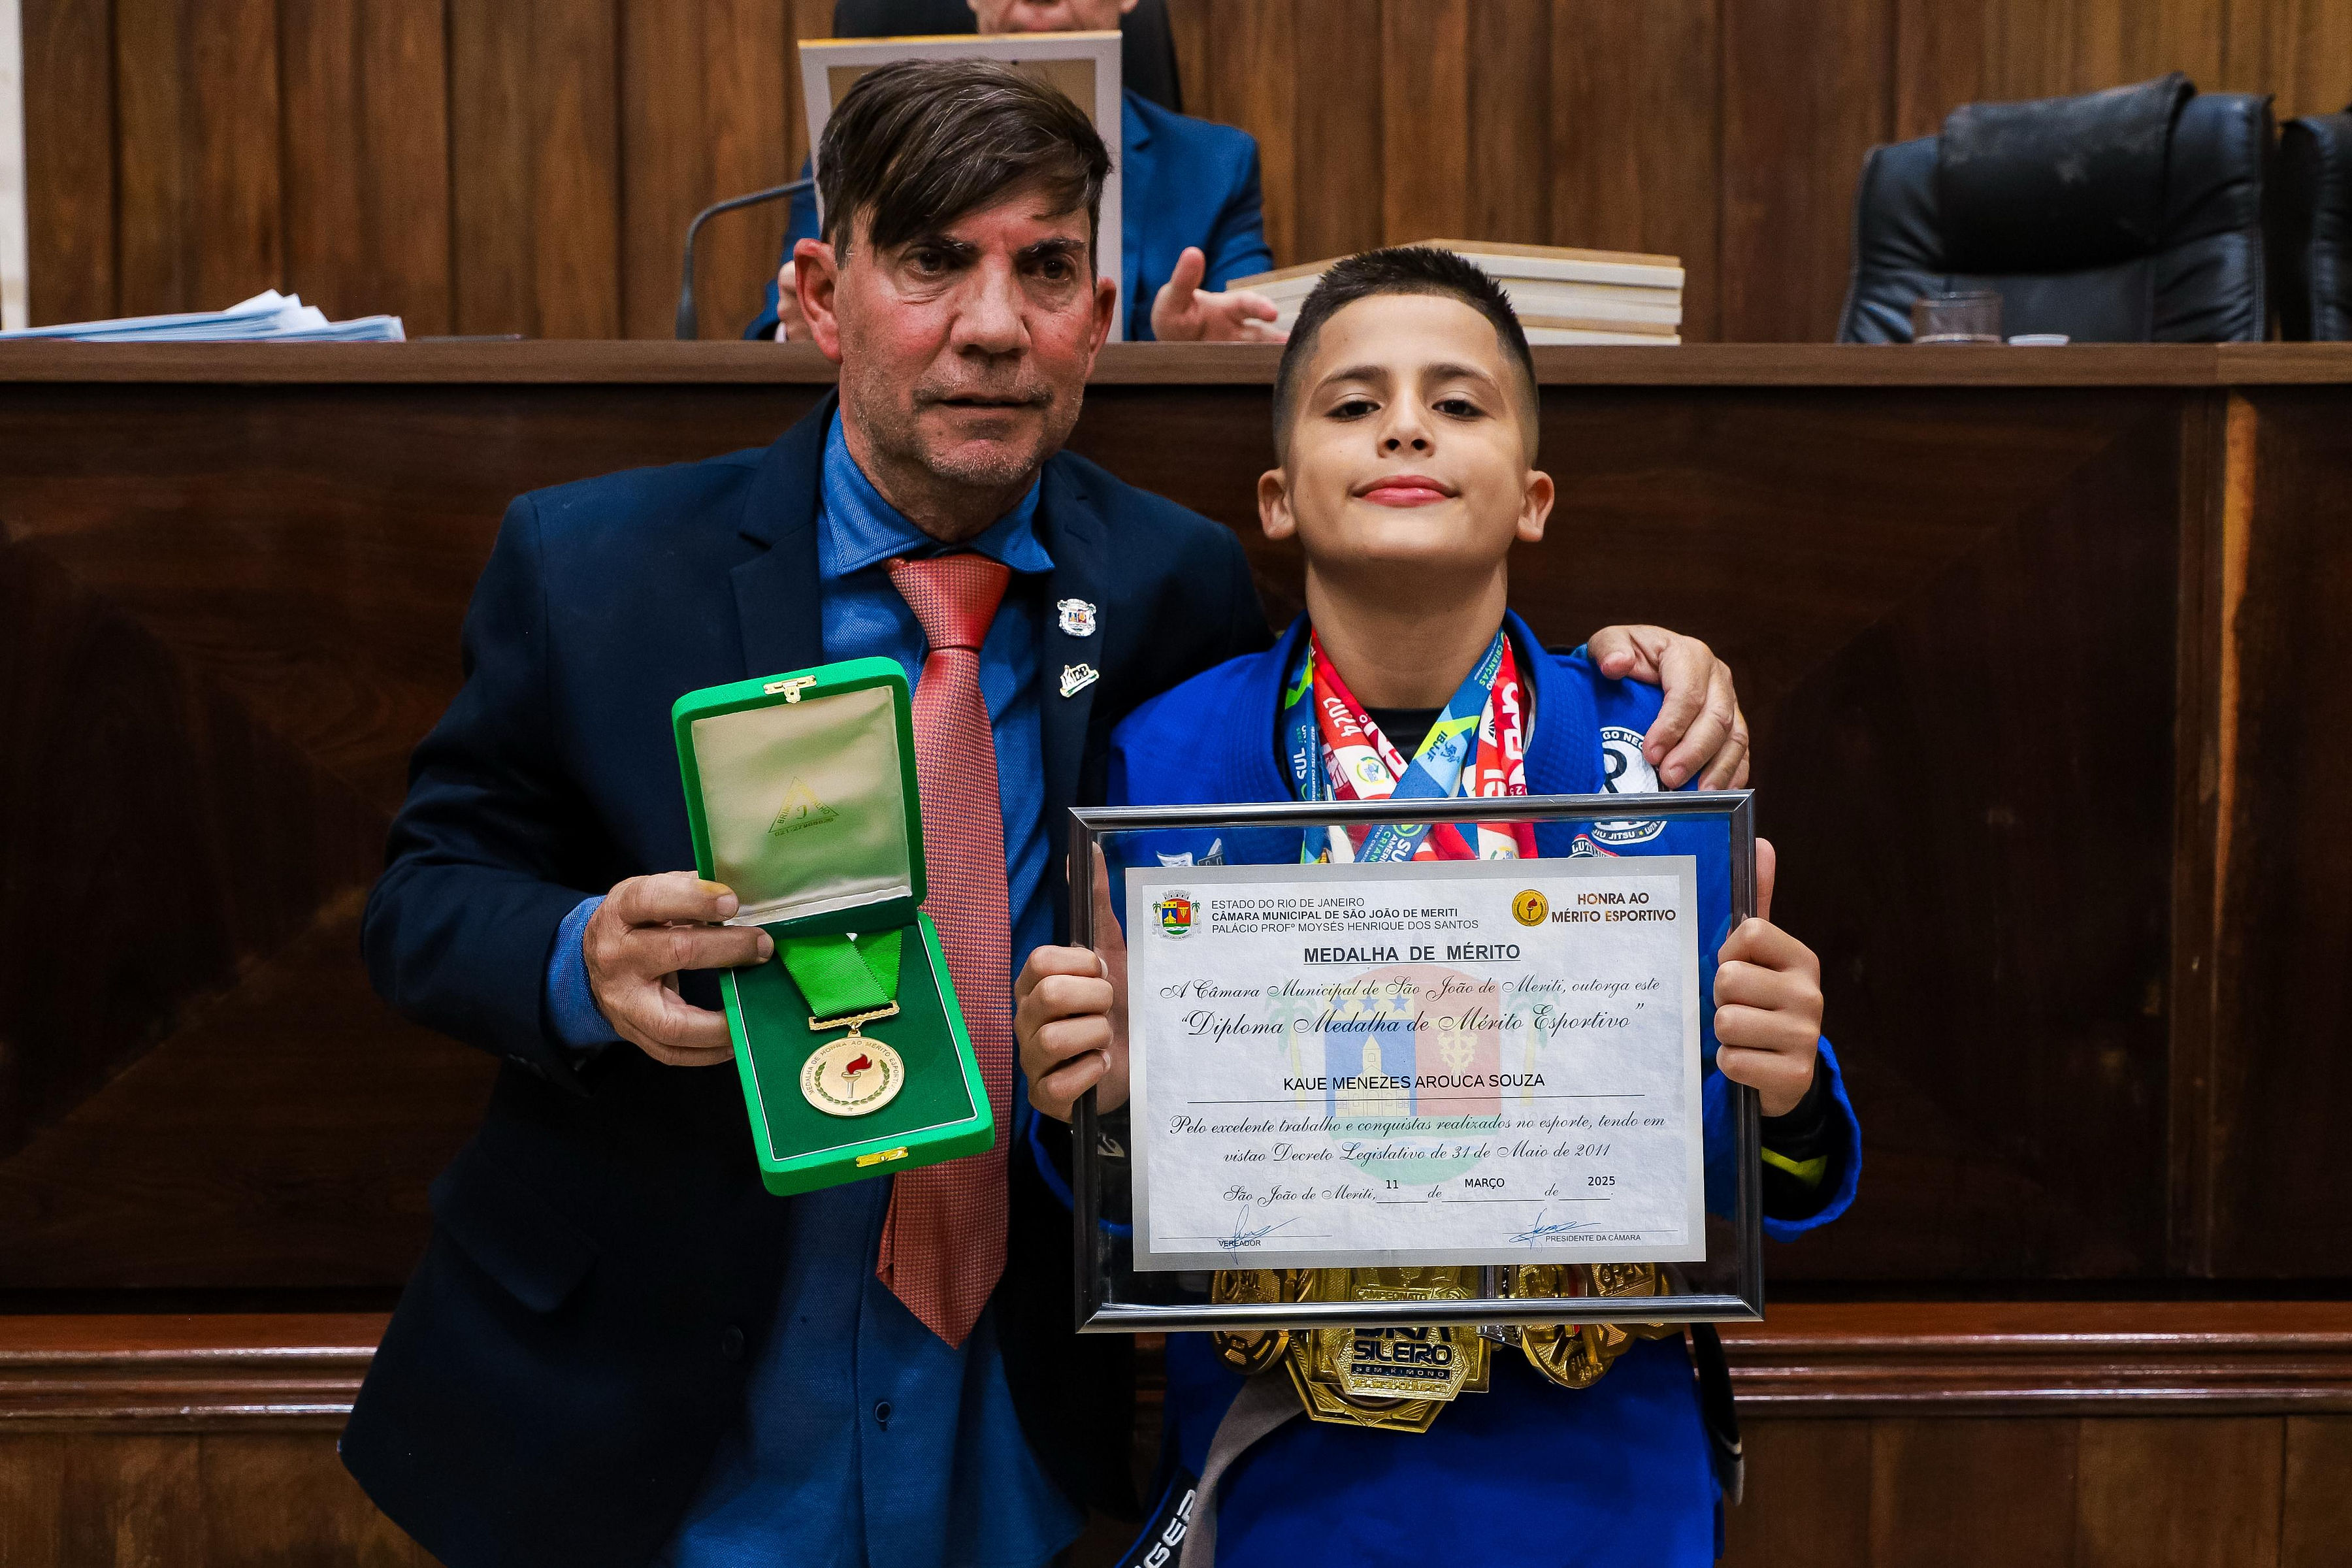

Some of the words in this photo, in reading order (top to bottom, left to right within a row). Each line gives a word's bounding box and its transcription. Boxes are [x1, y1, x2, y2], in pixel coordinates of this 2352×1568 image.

[1427, 730, 1448, 762] IBJJF
[1609, 831, 1635, 840] JITSU
[1391, 838, 1412, 862] SU
[1212, 900, 1256, 909] ESTADO
[1258, 899, 1274, 907] DO
[1277, 898, 1296, 907] RIO
[1299, 898, 1315, 907] DE
[1317, 898, 1364, 907] JANEIRO
[1578, 893, 1625, 905] HONRA
[1629, 892, 1649, 904] AO
[1212, 910, 1260, 921] CÂMARA
[1263, 911, 1321, 920] MUNICIPAL
[1325, 910, 1339, 919] DE
[1342, 908, 1365, 919] SÃO
[1369, 908, 1399, 919] JOÃO
[1403, 909, 1418, 918] DE
[1421, 908, 1458, 917] MERITI
[1552, 908, 1600, 923] MÉRITO
[1605, 909, 1676, 921] ESPORTIVO
[1213, 922, 1258, 933] PALÁCIO
[1298, 921, 1344, 932] MOYSÉS
[1348, 921, 1404, 931] HENRIQUE
[1408, 920, 1430, 930] DOS
[1434, 919, 1478, 929] SANTOS
[1304, 947, 1399, 962] MEDALHA
[1410, 946, 1435, 960] DE
[1447, 942, 1520, 959] MÉRITO
[1193, 979, 1260, 1000] Câmara
[1267, 979, 1360, 1002] Municipal
[1362, 979, 1379, 995] de
[1386, 976, 1420, 995] São
[1426, 976, 1474, 1002] João
[1478, 978, 1495, 993] de
[1502, 974, 1567, 992] Meriti,
[1572, 981, 1629, 998] outorga
[1635, 977, 1659, 990] este
[1294, 1011, 1400, 1034] Medalha
[1407, 1011, 1429, 1032] de
[1439, 1005, 1524, 1031] Mérito
[1533, 1004, 1630, 1037] Esportivo
[811, 1056, 821, 1066] DE
[1284, 1078, 1326, 1090] KAUE
[1332, 1076, 1410, 1090] MENEZES
[1415, 1075, 1484, 1088] AROUCA
[1489, 1073, 1545, 1086] SOUZA
[1169, 1115, 1207, 1134] Pelo
[1211, 1117, 1274, 1133] excelente
[1279, 1116, 1341, 1132] trabalho
[1345, 1122, 1353, 1130] e
[1357, 1117, 1431, 1136] conquistas
[1437, 1114, 1511, 1130] realizados
[1516, 1120, 1533, 1128] no
[1539, 1115, 1592, 1134] esporte,
[1599, 1111, 1638, 1127] tendo
[1644, 1117, 1665, 1126] em
[1271, 1143, 1333, 1161] Decreto
[1339, 1141, 1424, 1166] Legislativo
[1430, 1143, 1450, 1159] de
[1452, 1145, 1467, 1159] 31
[1474, 1143, 1490, 1158] de
[1497, 1140, 1547, 1158] Maio
[1554, 1142, 1570, 1156] de
[1575, 1143, 1610, 1156] 2011
[1224, 1184, 1253, 1200] São
[1258, 1184, 1297, 1207] João
[1302, 1185, 1316, 1200] de
[1322, 1184, 1375, 1201] Meriti,
[1386, 1180, 1399, 1188] 11
[1428, 1186, 1442, 1198] de
[1465, 1179, 1504, 1188] MARÇO
[1544, 1183, 1558, 1196] de
[1588, 1176, 1615, 1186] 2025
[1352, 1340, 1453, 1366] SILEIRO
[1390, 1367, 1445, 1377] KIMONO
[1134, 1489, 1197, 1568] GER
